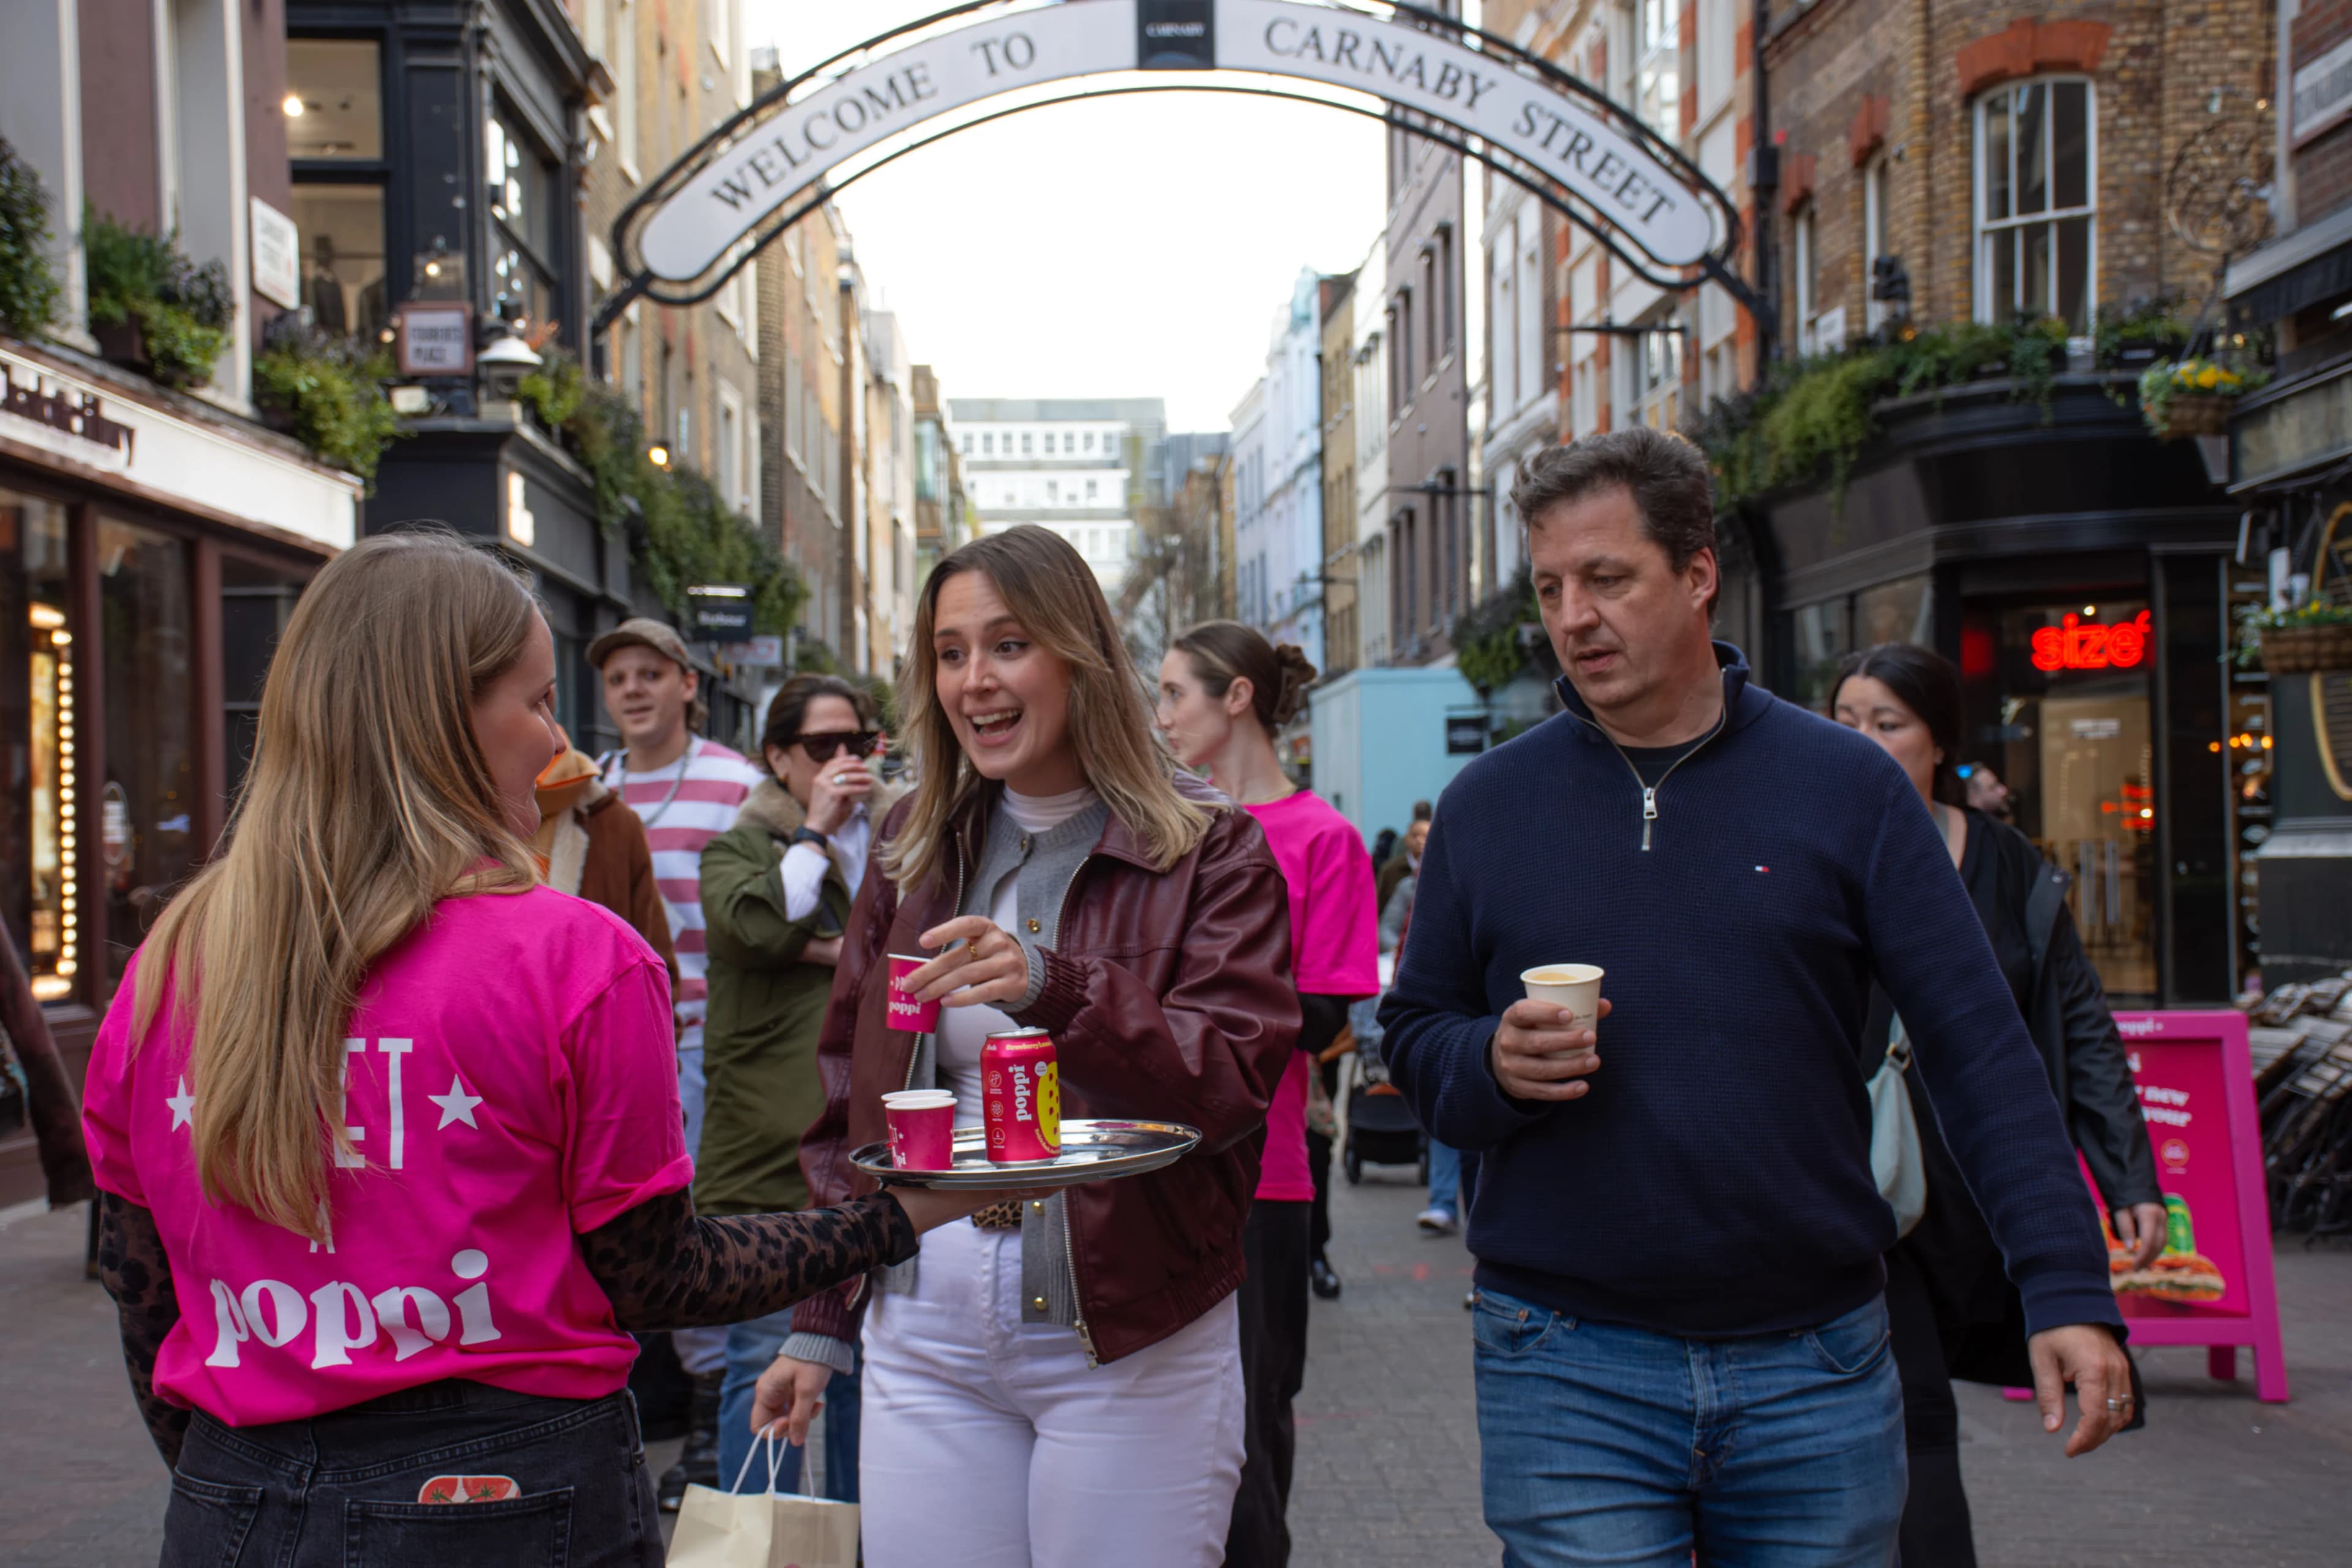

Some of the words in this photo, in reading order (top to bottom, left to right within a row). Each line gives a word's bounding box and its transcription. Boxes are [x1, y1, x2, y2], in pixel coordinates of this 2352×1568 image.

[710, 61, 938, 213] WELCOME
[970, 31, 1036, 78] TO
[1264, 17, 1496, 111] CARNABY
[1512, 100, 1676, 227] STREET
[889, 1001, 922, 1016] poppi
[2116, 1018, 2154, 1035] oppi
[334, 1038, 413, 1169] ET
[1008, 1065, 1032, 1122] poppi
[204, 1249, 502, 1369] poppi
